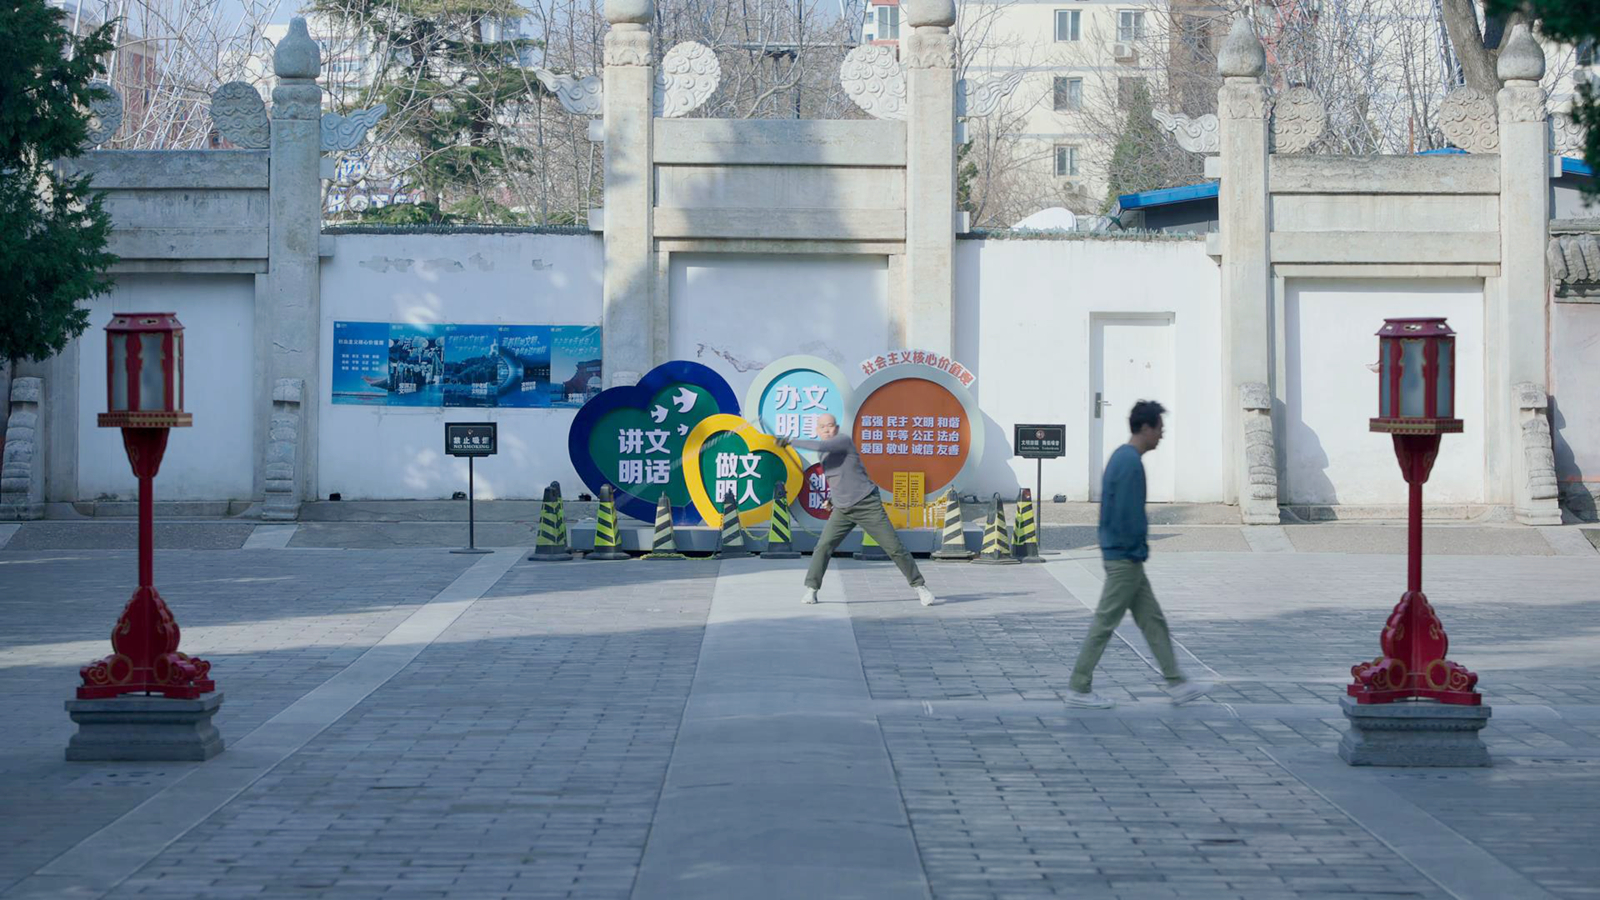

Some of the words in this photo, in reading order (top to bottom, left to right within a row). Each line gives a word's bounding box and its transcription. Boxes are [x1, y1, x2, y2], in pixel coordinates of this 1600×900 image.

[862, 350, 974, 387] 社会主义核心价值观
[776, 385, 828, 411] 办文
[776, 413, 820, 439] 明事
[861, 415, 883, 428] 富强
[887, 416, 908, 428] 民主
[912, 416, 934, 428] 文明
[937, 416, 960, 429] 和谐
[618, 428, 671, 454] 讲文
[861, 429, 883, 441] 自由
[886, 430, 908, 441] 平等
[912, 430, 934, 442] 公正
[937, 431, 960, 443] 法治
[861, 443, 883, 455] 爱国
[886, 443, 908, 455] 敬业
[911, 444, 934, 456] 诚信
[937, 444, 960, 457] 友善
[618, 459, 671, 484] 明话
[715, 452, 762, 479] 做文
[715, 479, 761, 505] 明人
[809, 472, 830, 491] 创
[808, 491, 831, 509] 明
